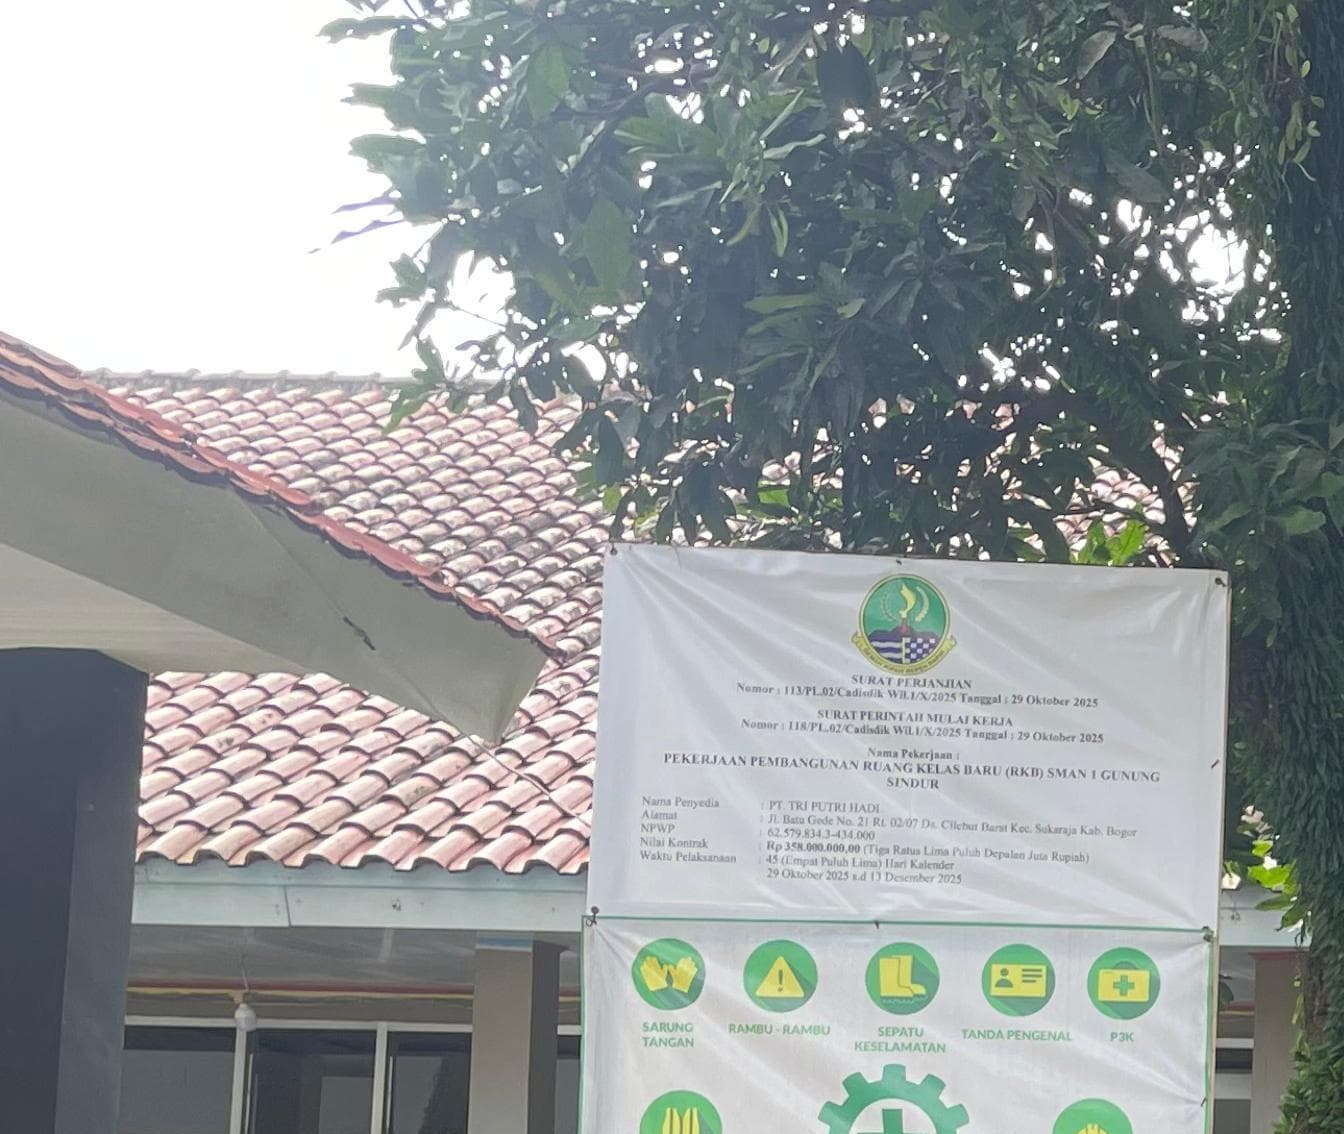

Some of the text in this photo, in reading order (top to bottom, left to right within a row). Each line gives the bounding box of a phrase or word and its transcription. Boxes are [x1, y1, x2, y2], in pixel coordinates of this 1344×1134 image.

[852, 675, 972, 689] SURAT PERJANJIAN
[737, 682, 772, 694] Nomor
[960, 693, 1001, 706] Tanggal
[1012, 694, 1024, 704] 29
[1026, 695, 1069, 706] Oktober
[1074, 698, 1099, 708] 2025
[818, 709, 1013, 727] SURAT PERINTAH MULAI KERJA
[741, 719, 778, 730] Nomor
[966, 729, 1007, 741] Tanggal
[1017, 732, 1028, 741] 29
[1033, 732, 1076, 742] Oktober
[1080, 733, 1104, 743] 2025
[868, 748, 898, 758] Nama
[902, 748, 952, 762] Pekerjaan
[664, 753, 747, 766] PEKERJAAN
[751, 756, 859, 770] PEMBANGUNAN
[863, 760, 913, 774] RUANG
[916, 764, 960, 775] KELAS
[964, 765, 1000, 776] BARU
[1005, 766, 1044, 780] (RKB)
[1047, 768, 1086, 780] SMAN
[1100, 770, 1160, 782] GUNUNG
[886, 776, 939, 789] SINDUR
[642, 796, 719, 810] Nama Penyedia
[789, 801, 807, 811] TRI
[811, 802, 846, 812] PUTRI
[850, 803, 880, 813] HADI
[641, 810, 677, 820] Alamat
[641, 824, 675, 833] NPWP
[783, 814, 804, 824] Batu
[808, 815, 833, 826] Gede
[858, 817, 869, 826] 21
[1035, 824, 1077, 836] Sukaraja
[1107, 826, 1138, 838] Bogor
[640, 837, 708, 848] Nilai Kontrak
[640, 850, 736, 863] Waktu Pelaksanaan
[766, 842, 782, 852] Rp
[863, 844, 890, 855] (Tiga
[893, 844, 920, 855] Ratus
[924, 846, 949, 856] Lima
[952, 847, 980, 857] Puluh
[1028, 850, 1048, 860] Juta
[1051, 851, 1090, 864] Rupiah)
[766, 854, 778, 864] 45
[821, 855, 849, 866] Puluh
[852, 857, 882, 868] Lima)
[885, 858, 907, 868] Hari
[910, 859, 954, 870] Kalender
[766, 868, 779, 878] 29
[782, 869, 823, 880] Oktober
[826, 870, 849, 880] 2025
[885, 871, 934, 883] Desember
[938, 873, 962, 884] 2025
[642, 1022, 693, 1033] SARUNG
[729, 1024, 772, 1034] RAMBU
[783, 1024, 830, 1035] RAMBU
[878, 1027, 924, 1038] SEPATU
[962, 1028, 1072, 1042] TANDA PENGENAL
[1110, 1032, 1134, 1042] P3K
[642, 1037, 694, 1047] TANGAN
[854, 1041, 946, 1053] KESELAMATAN
